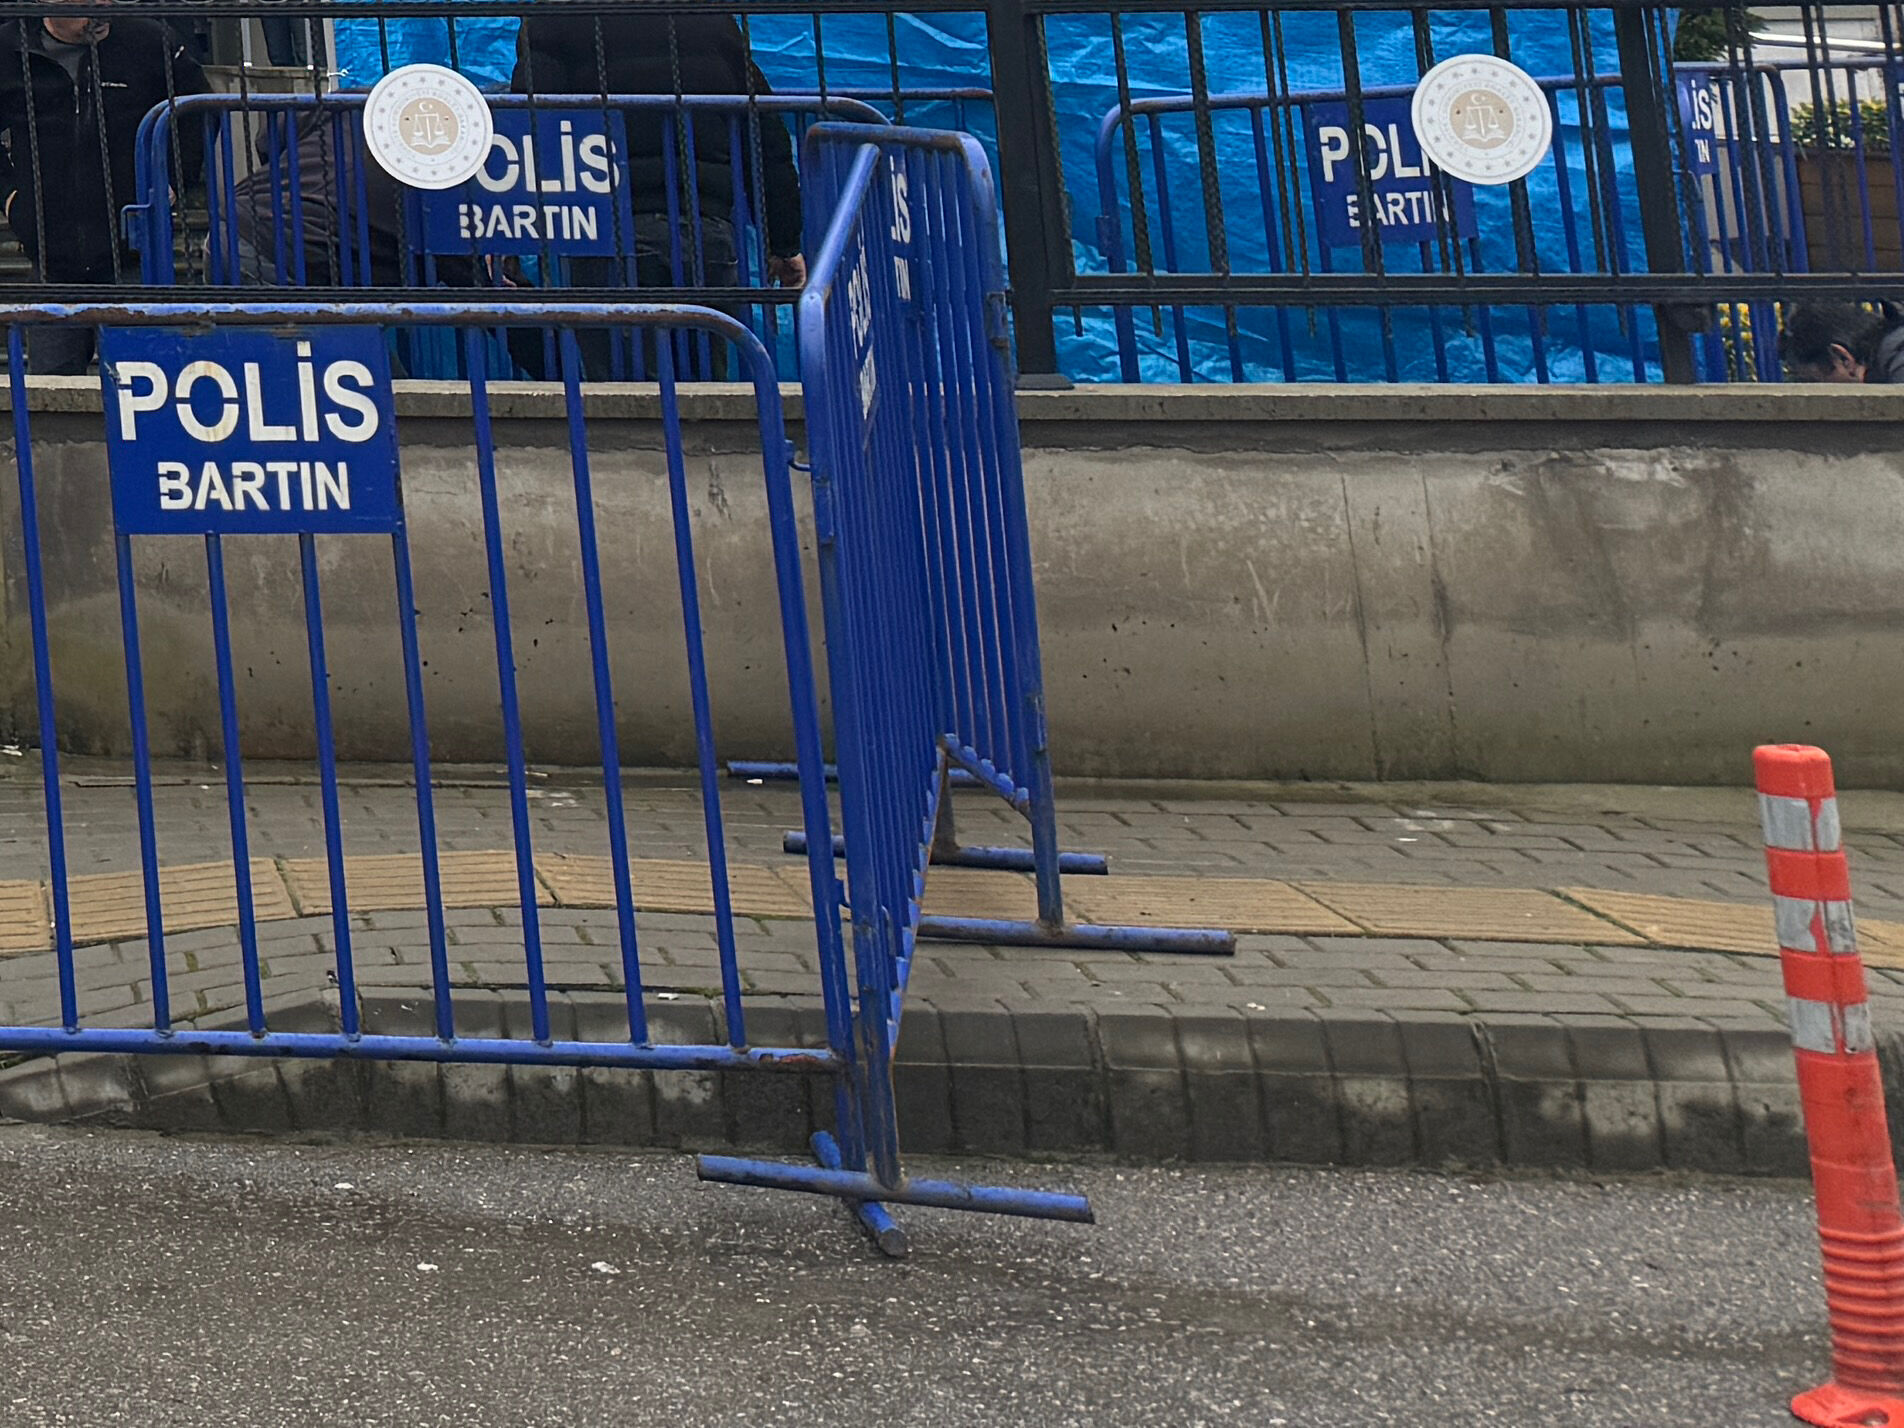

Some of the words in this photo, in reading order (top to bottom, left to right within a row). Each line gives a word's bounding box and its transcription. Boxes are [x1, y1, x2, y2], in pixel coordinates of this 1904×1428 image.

[475, 120, 621, 193] OLİS
[1319, 123, 1432, 182] POL
[459, 204, 597, 240] BARTIN
[115, 340, 379, 443] POLİS
[157, 461, 351, 511] BARTIN
